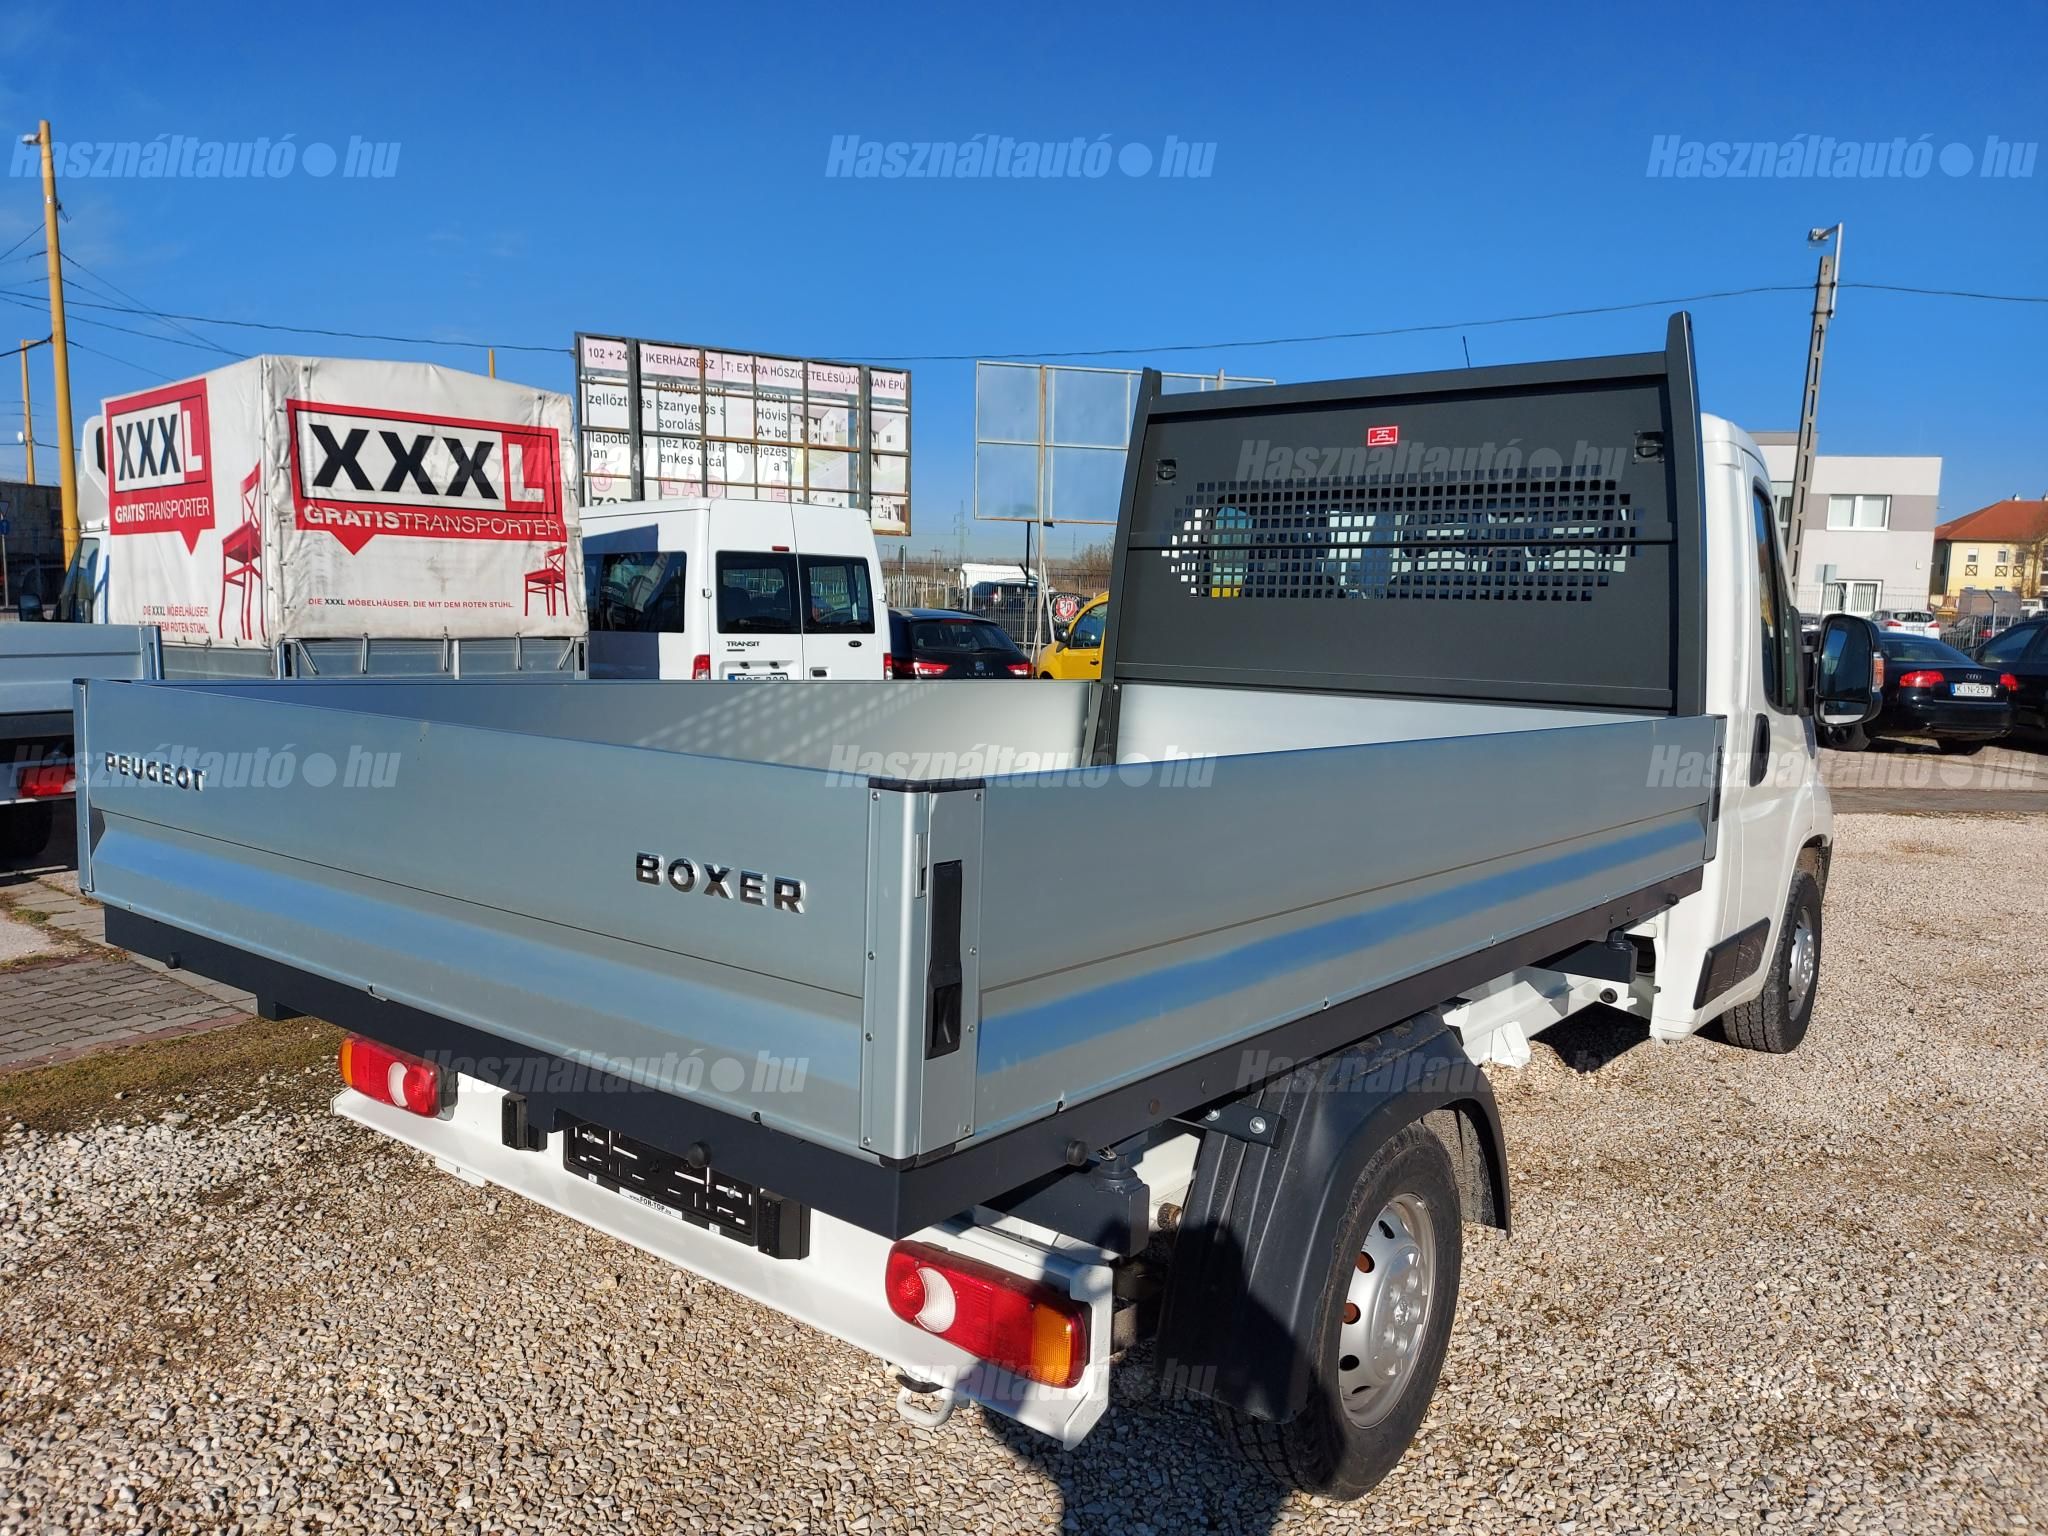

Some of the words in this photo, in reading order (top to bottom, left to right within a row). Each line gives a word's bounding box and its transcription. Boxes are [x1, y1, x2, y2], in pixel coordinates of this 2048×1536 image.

[588, 347, 605, 359] 102
[116, 410, 203, 481] XXXL
[308, 423, 546, 502] XXXL
[324, 598, 346, 606] XXXL
[413, 600, 427, 608] DIE
[428, 600, 442, 608] MIT
[462, 601, 488, 609] ROTEN
[105, 751, 207, 792] PEUGEOT
[636, 851, 807, 914] BOXER
